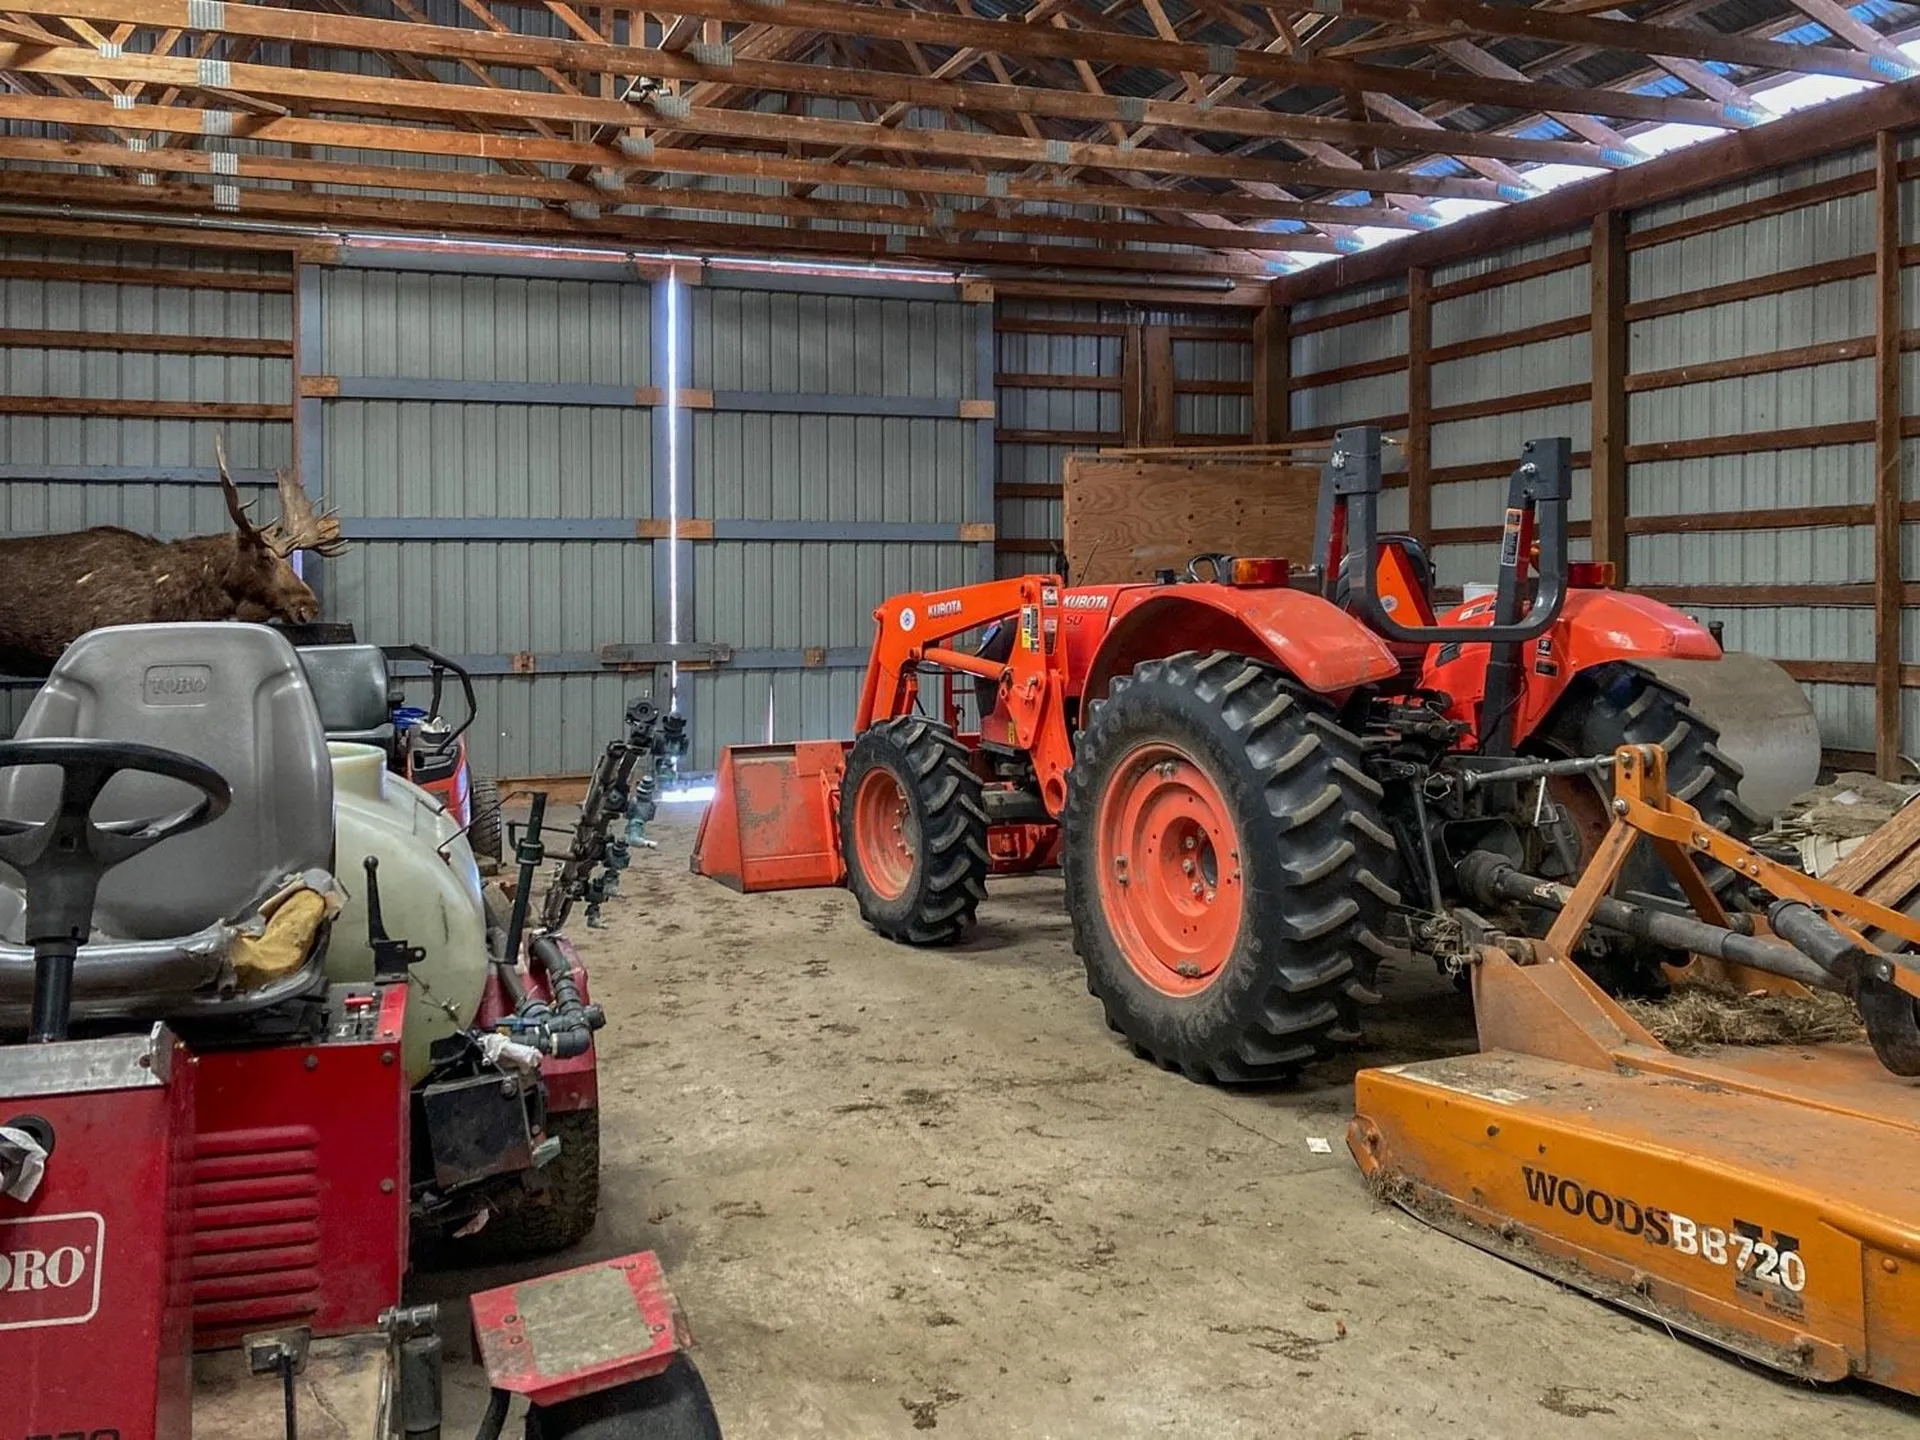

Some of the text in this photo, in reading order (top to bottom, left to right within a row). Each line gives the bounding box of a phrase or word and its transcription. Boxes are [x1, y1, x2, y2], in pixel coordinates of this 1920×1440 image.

[927, 600, 962, 617] KUBOTA
[1063, 595, 1108, 609] KUBOTA
[1522, 1166, 1670, 1246] WOODS
[0, 1246, 85, 1291] RO
